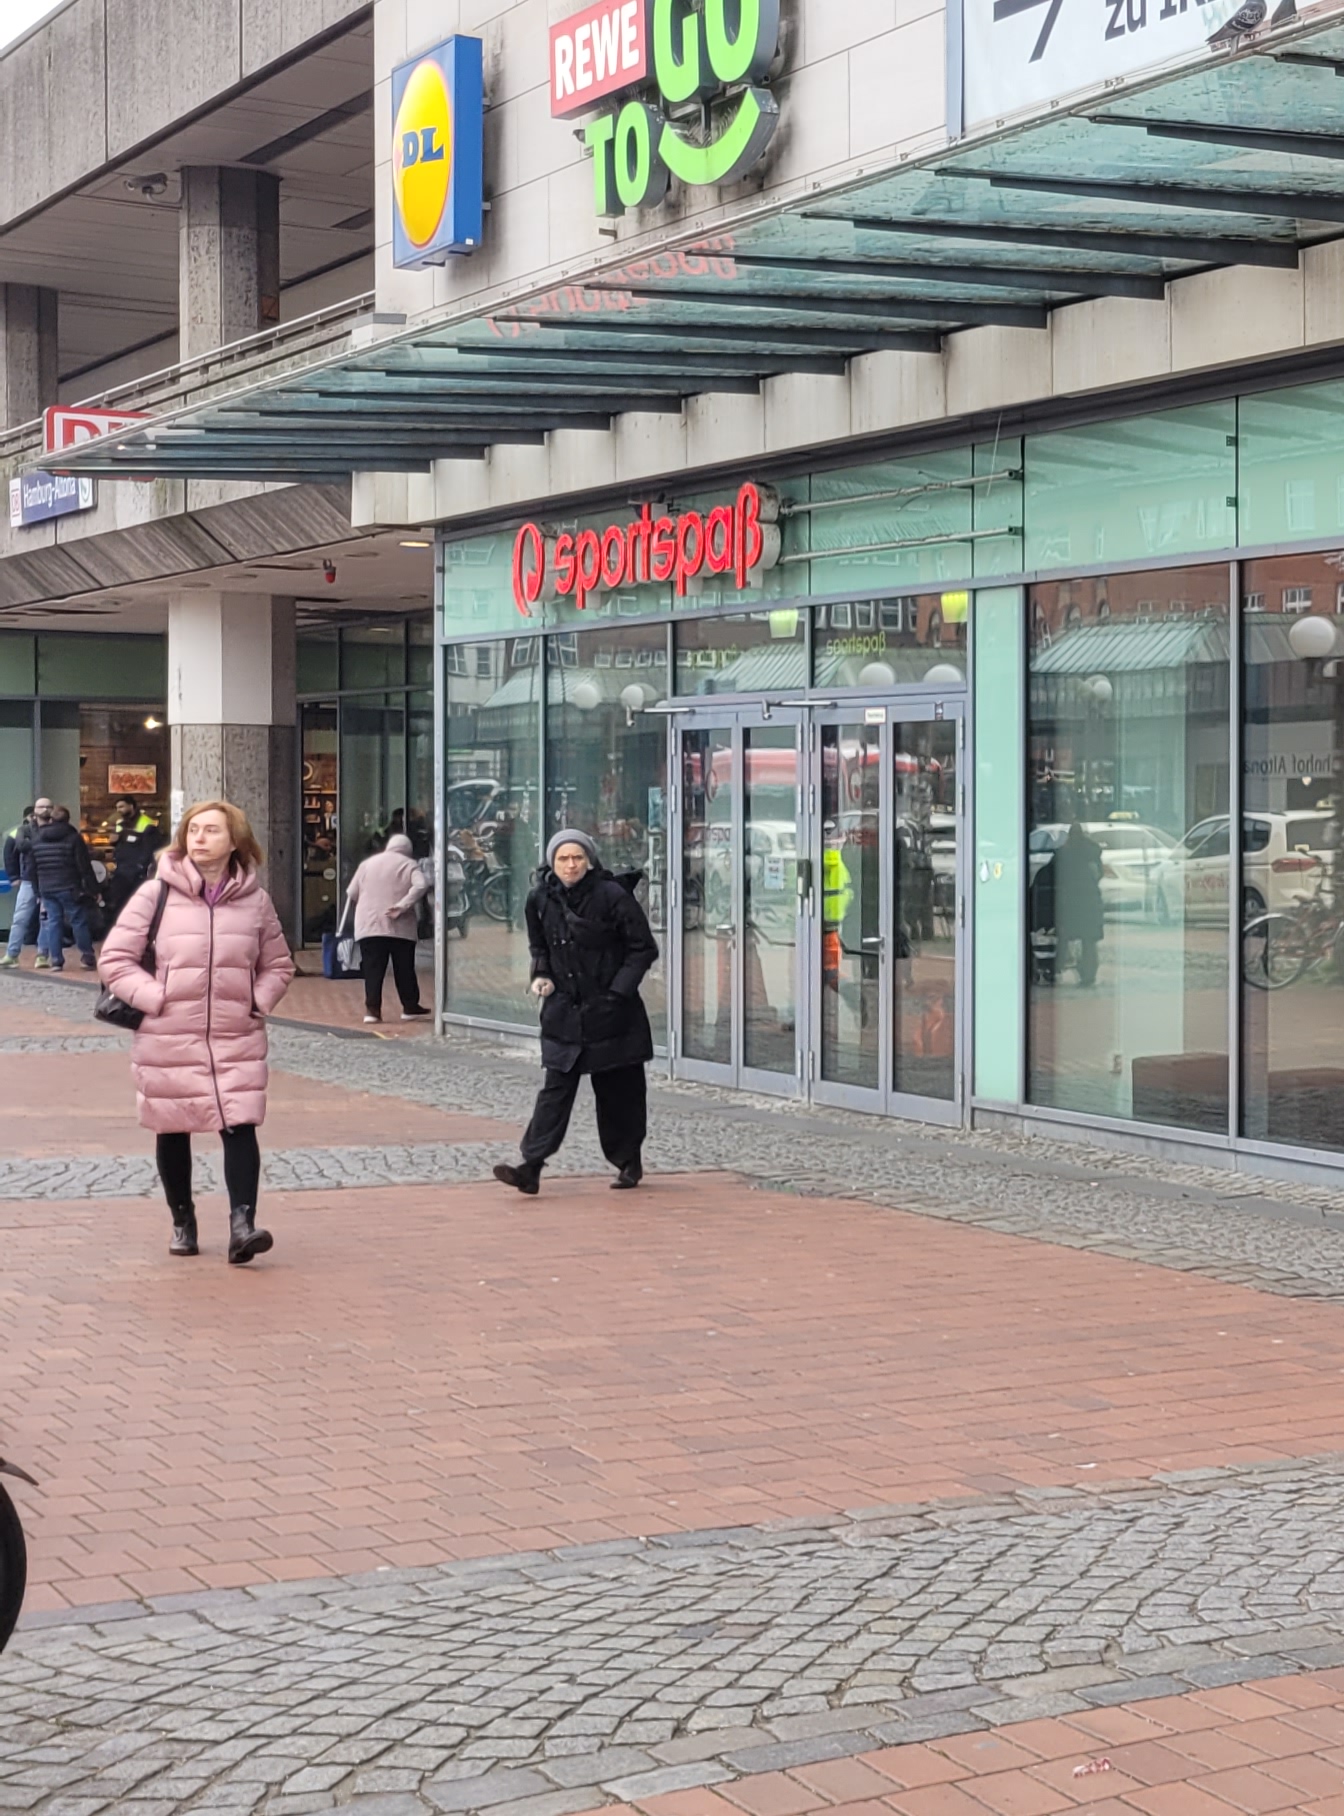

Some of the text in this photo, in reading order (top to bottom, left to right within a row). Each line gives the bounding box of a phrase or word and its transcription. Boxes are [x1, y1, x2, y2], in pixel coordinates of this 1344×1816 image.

[554, 0, 640, 100] REWE
[653, 0, 760, 102] GO
[585, 101, 650, 217] TO
[553, 482, 764, 610] sportspaß
